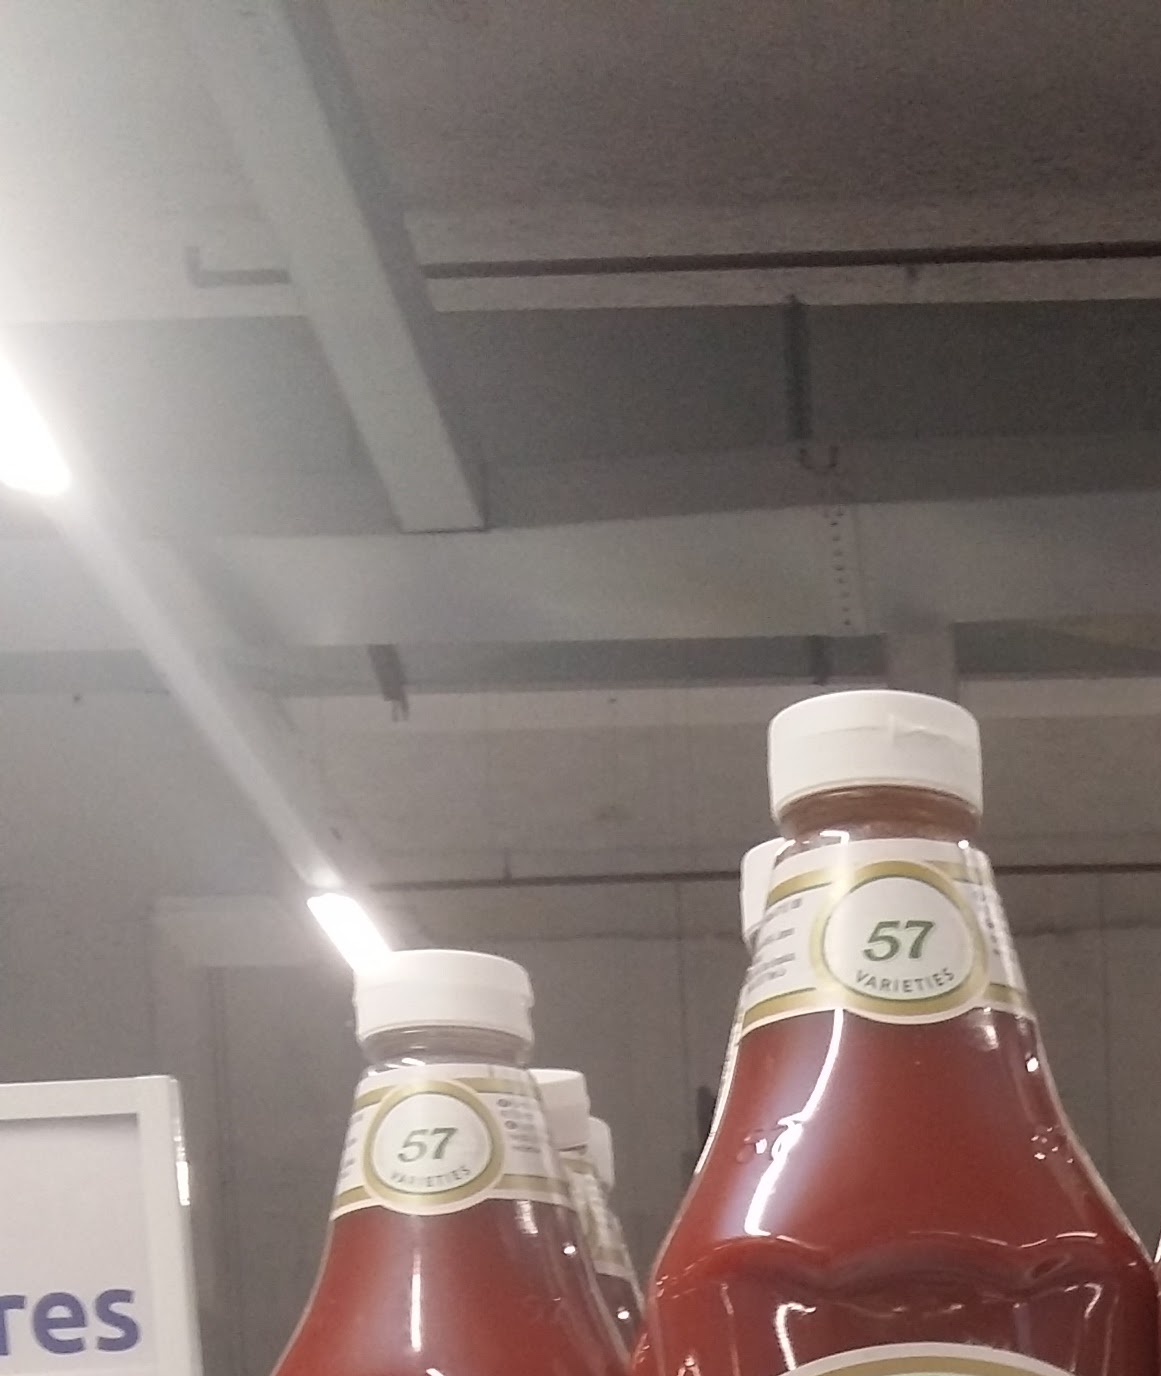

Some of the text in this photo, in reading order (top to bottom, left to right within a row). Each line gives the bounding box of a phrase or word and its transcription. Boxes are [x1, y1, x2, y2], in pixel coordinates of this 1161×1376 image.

[864, 920, 935, 962] 57
[855, 966, 956, 994] VARIETIES
[397, 1127, 459, 1164] 57
